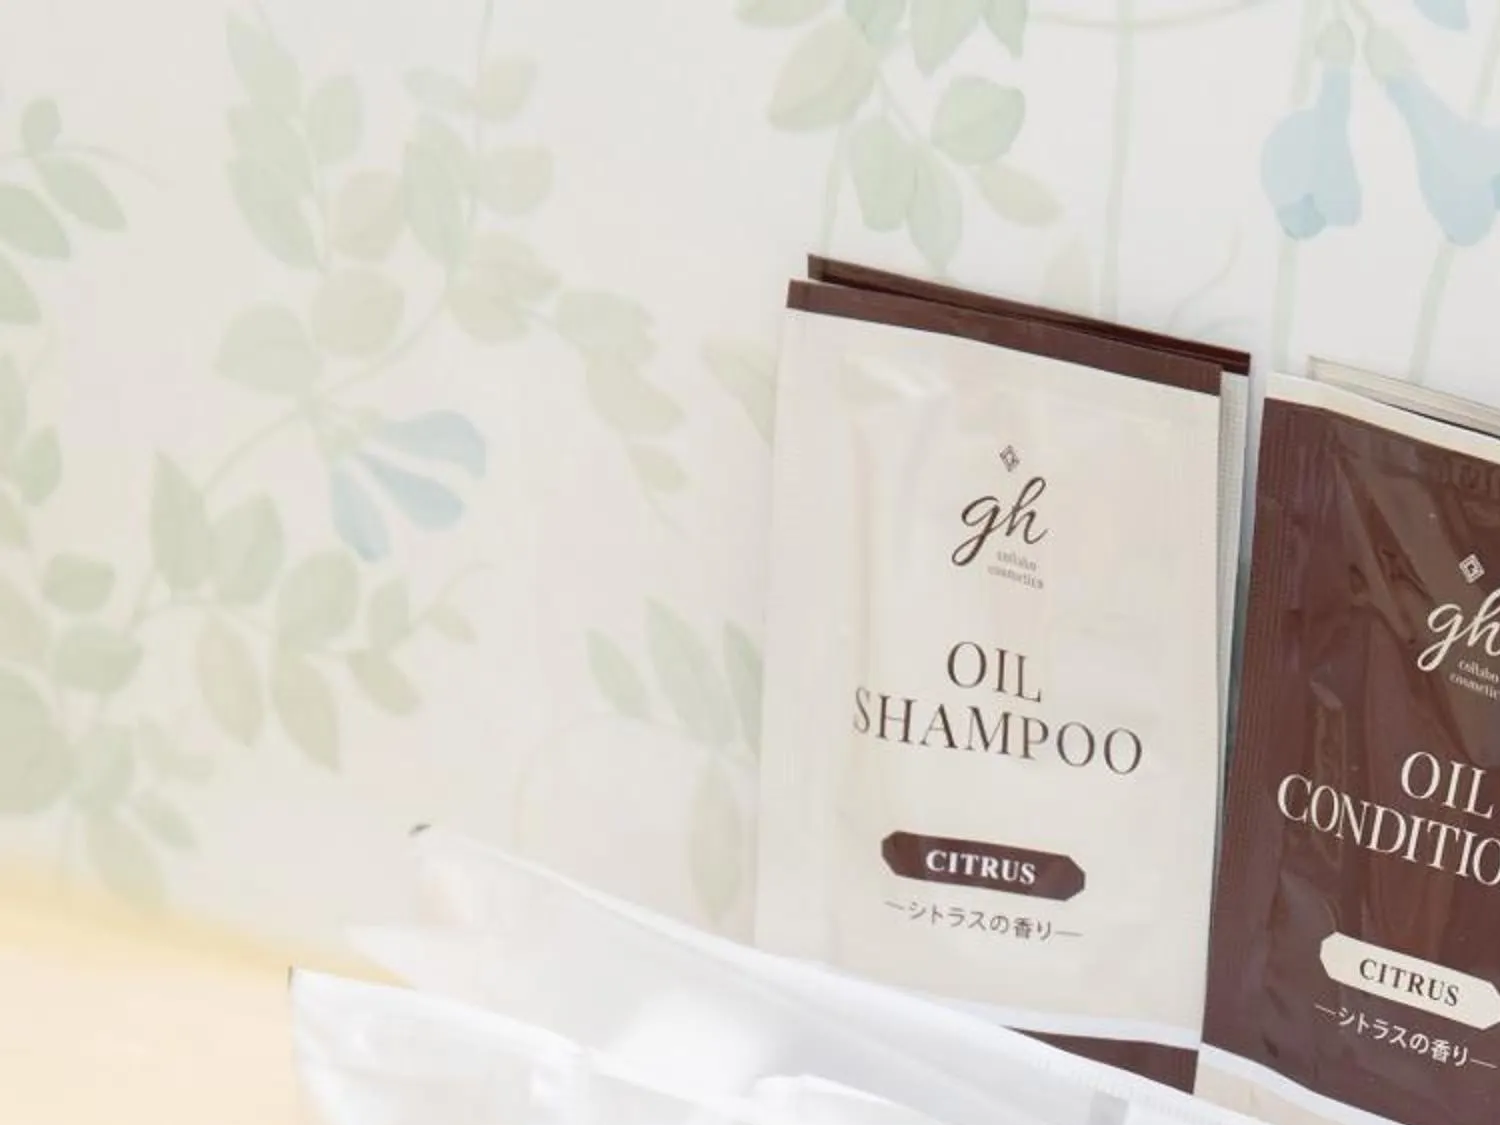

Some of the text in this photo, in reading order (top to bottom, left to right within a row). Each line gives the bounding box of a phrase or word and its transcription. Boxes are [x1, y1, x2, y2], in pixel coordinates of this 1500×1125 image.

[951, 476, 1049, 567] gh
[945, 640, 1042, 703] OIL
[1457, 658, 1500, 684] collabo
[852, 686, 1144, 776] SHAMPOO
[1400, 750, 1494, 820] OIL
[924, 848, 1037, 887] CITRUS
[1358, 958, 1461, 1008] CITRUS
